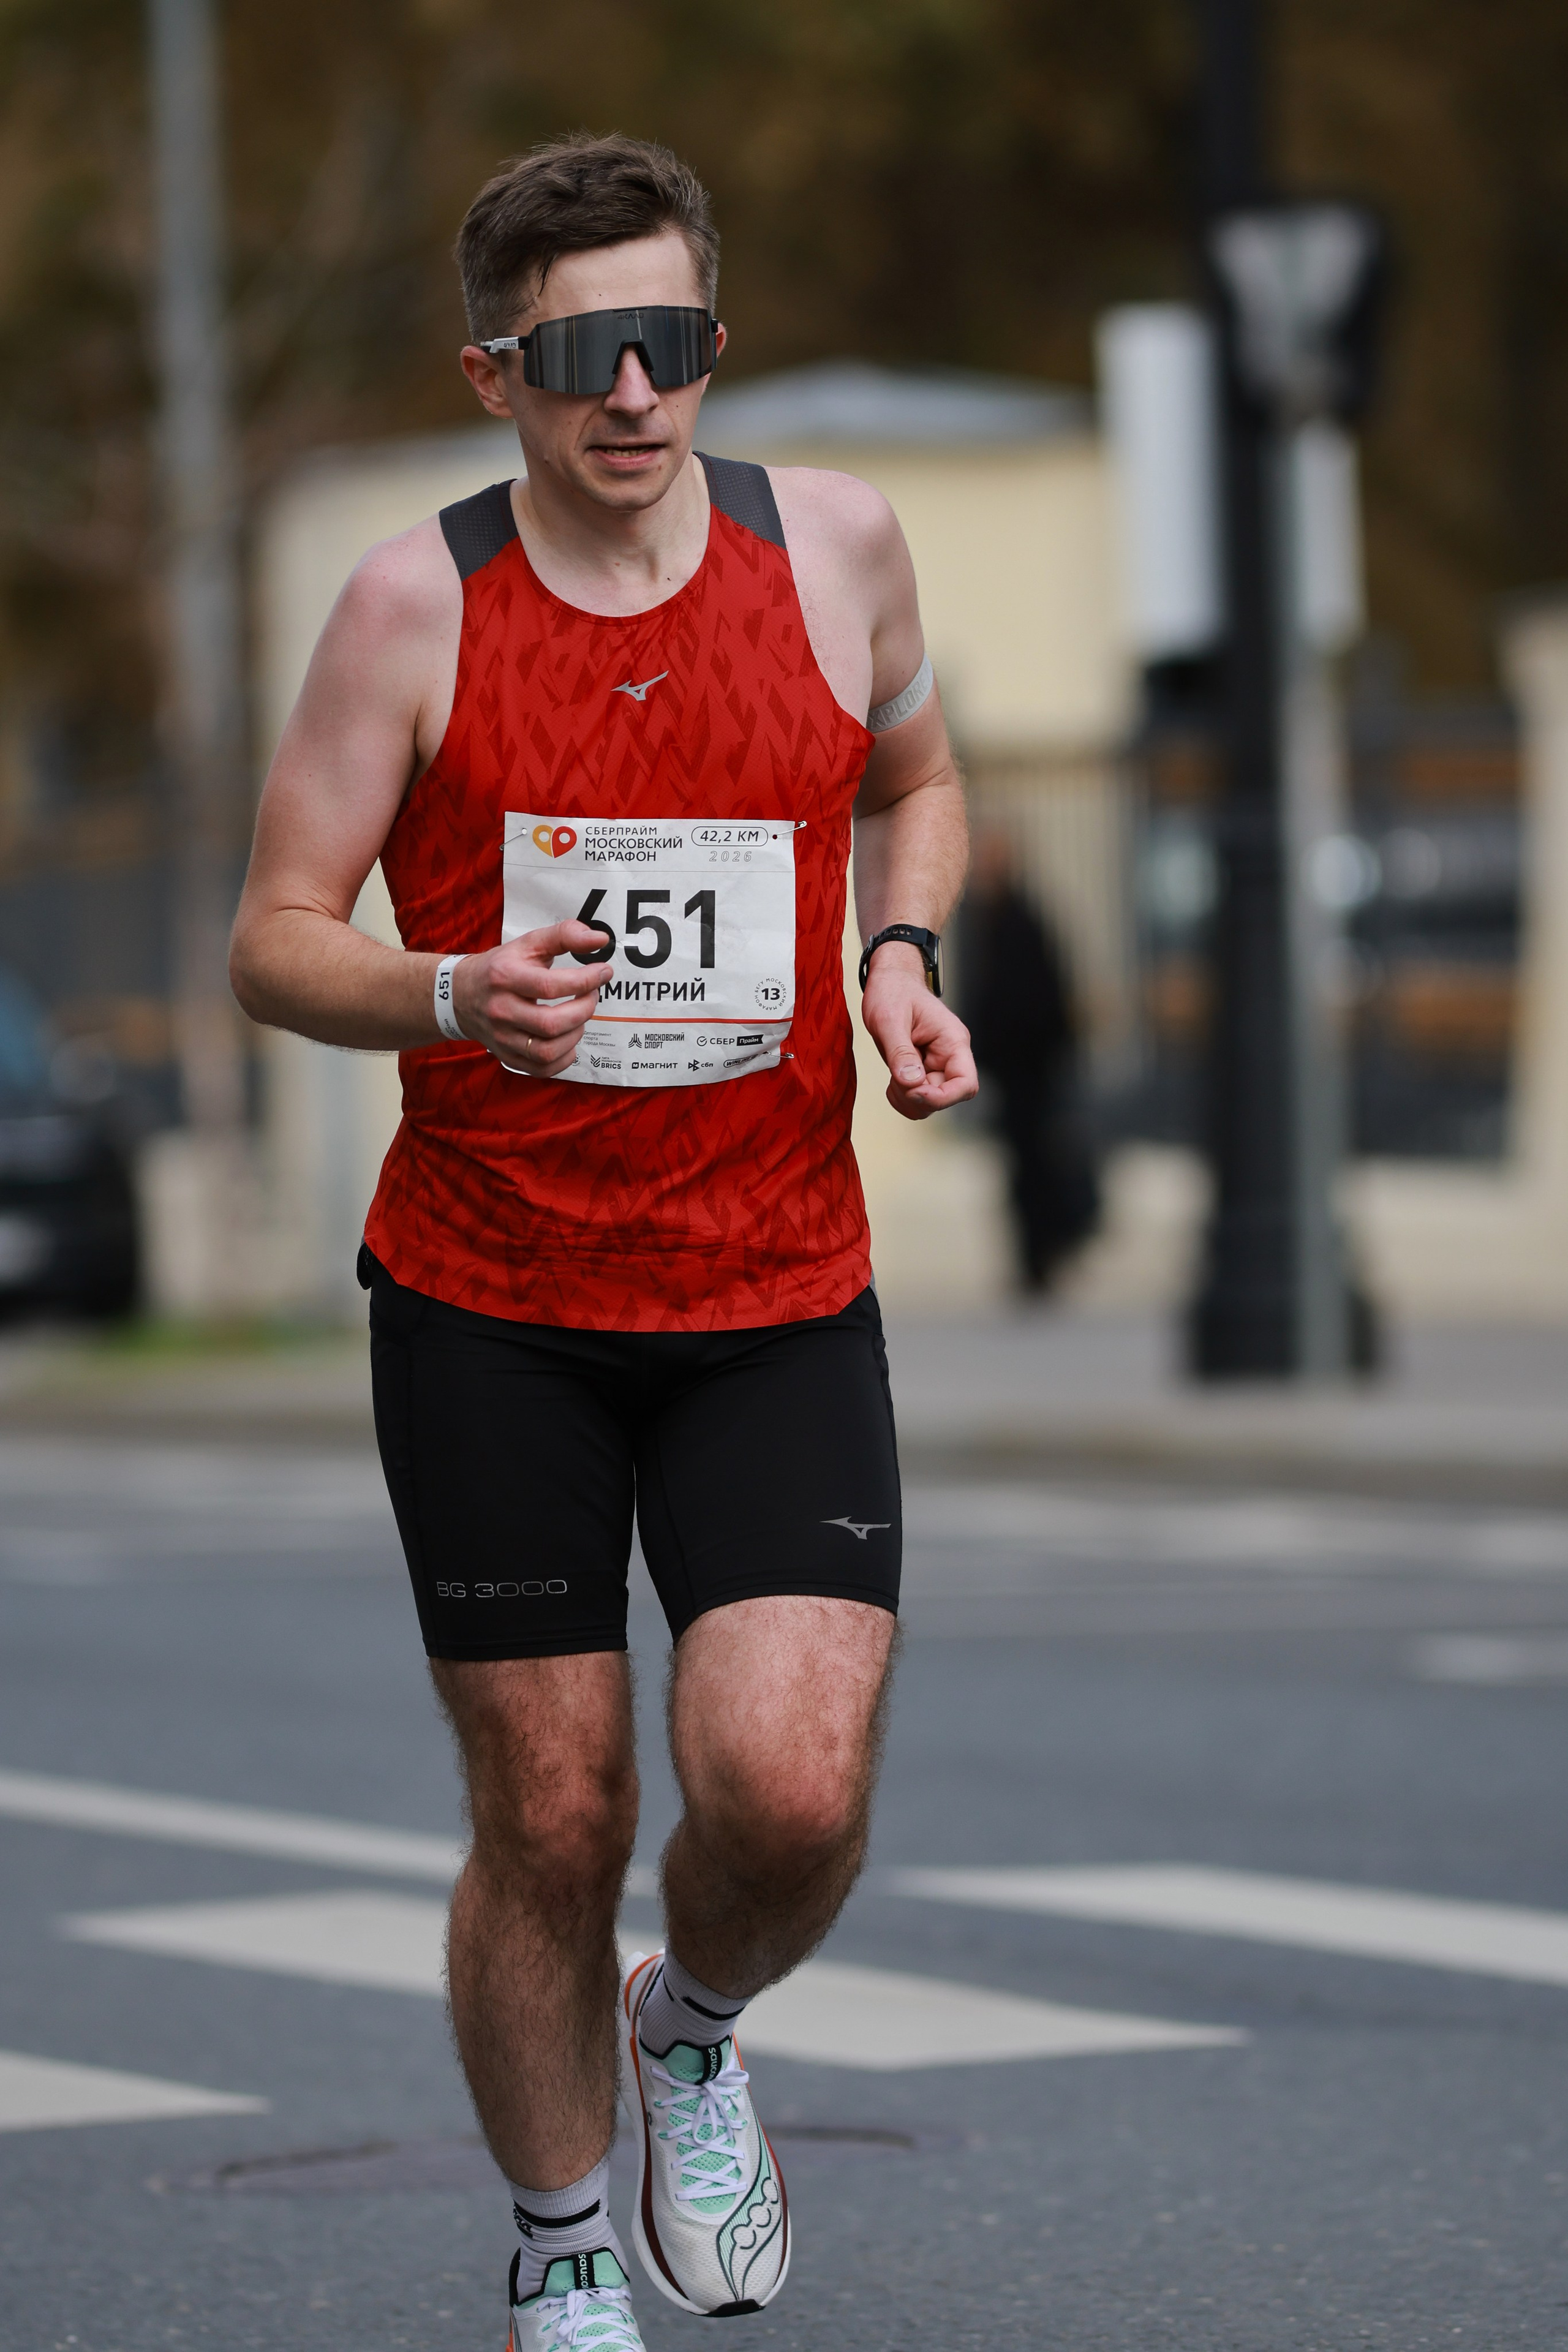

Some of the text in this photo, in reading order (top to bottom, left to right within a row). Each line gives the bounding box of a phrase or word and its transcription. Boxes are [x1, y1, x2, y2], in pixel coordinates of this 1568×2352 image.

[586, 826, 657, 835] СБЕРПРАЙМ
[585, 837, 682, 849] МОСКОВСКИЙ
[700, 831, 731, 843] 42,2
[585, 850, 657, 862] МАРАФОН
[709, 850, 752, 862] 2026
[570, 889, 715, 968] 651
[439, 972, 450, 1000] 651
[598, 978, 705, 1003] МИТРИЙ
[761, 988, 780, 1000] 13
[645, 1032, 685, 1041] МОСКОВСКИЙ
[437, 1580, 567, 1597] BG 3000
